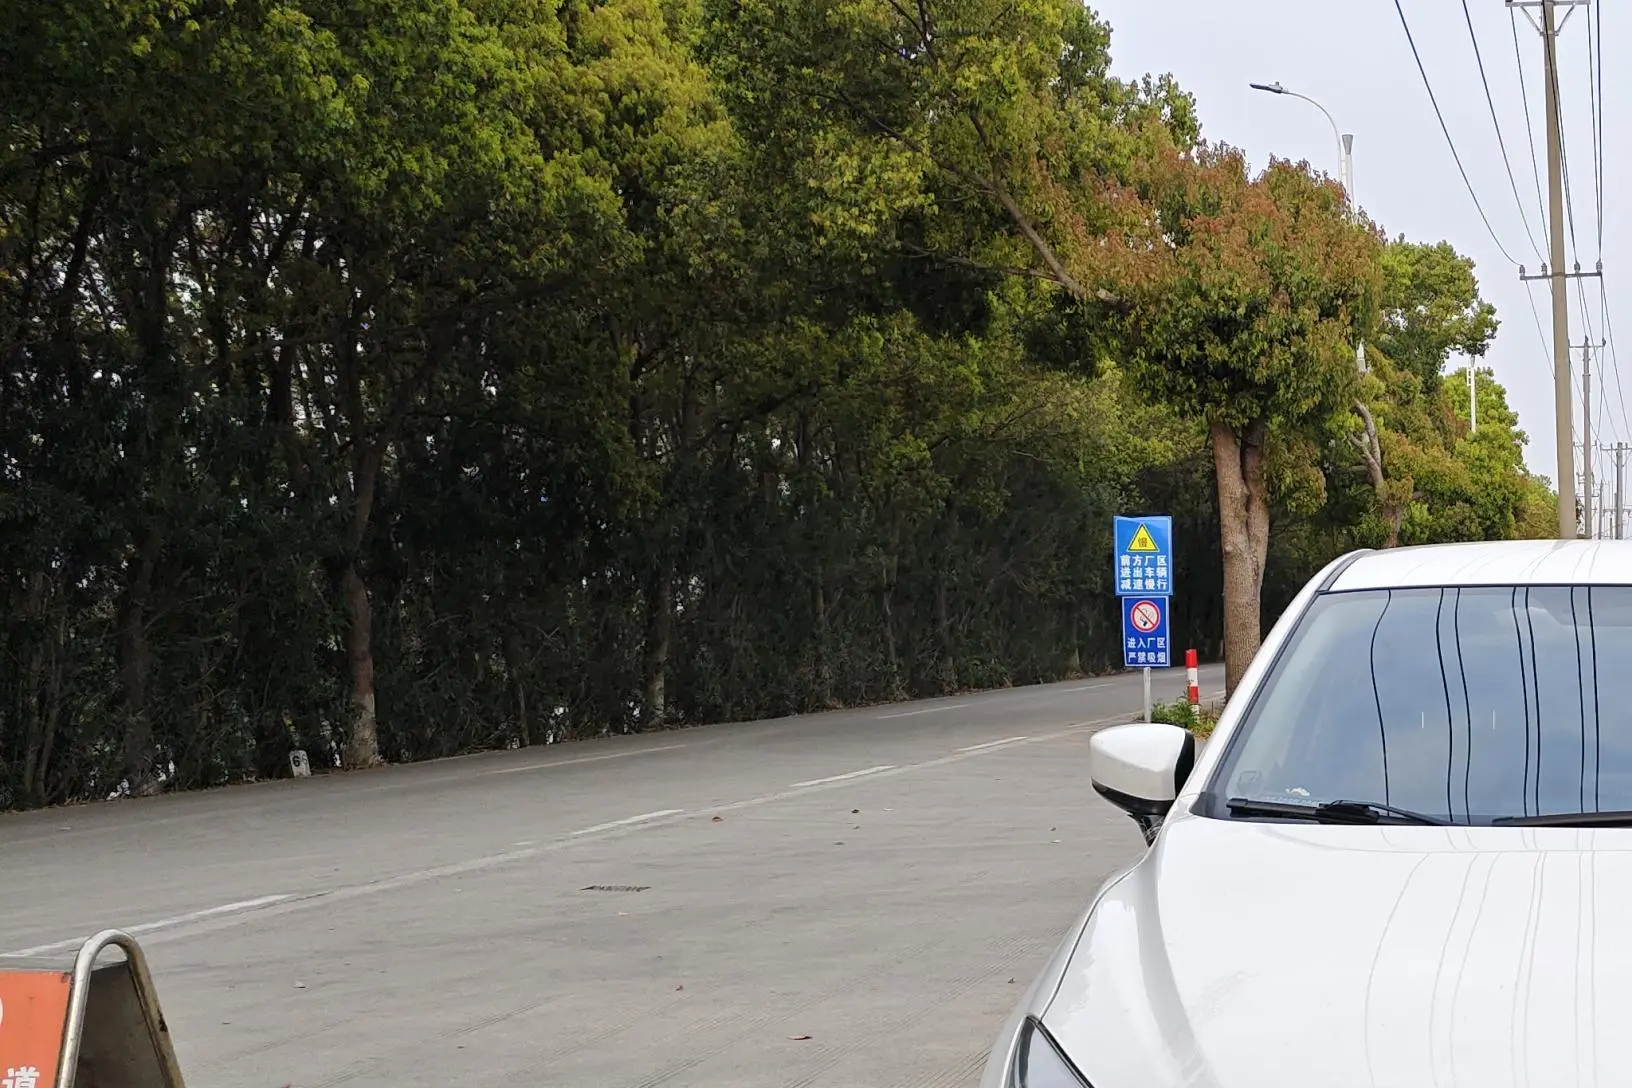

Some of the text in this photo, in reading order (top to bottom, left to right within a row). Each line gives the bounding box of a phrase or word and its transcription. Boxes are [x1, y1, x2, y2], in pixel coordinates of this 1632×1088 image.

[1120, 555, 1167, 567] 前方厂区
[1120, 566, 1168, 578] 进出车辆
[1120, 578, 1168, 590] 减速慢行
[1127, 637, 1166, 649] 进入厂区
[1128, 651, 1166, 663] 严禁吸烟
